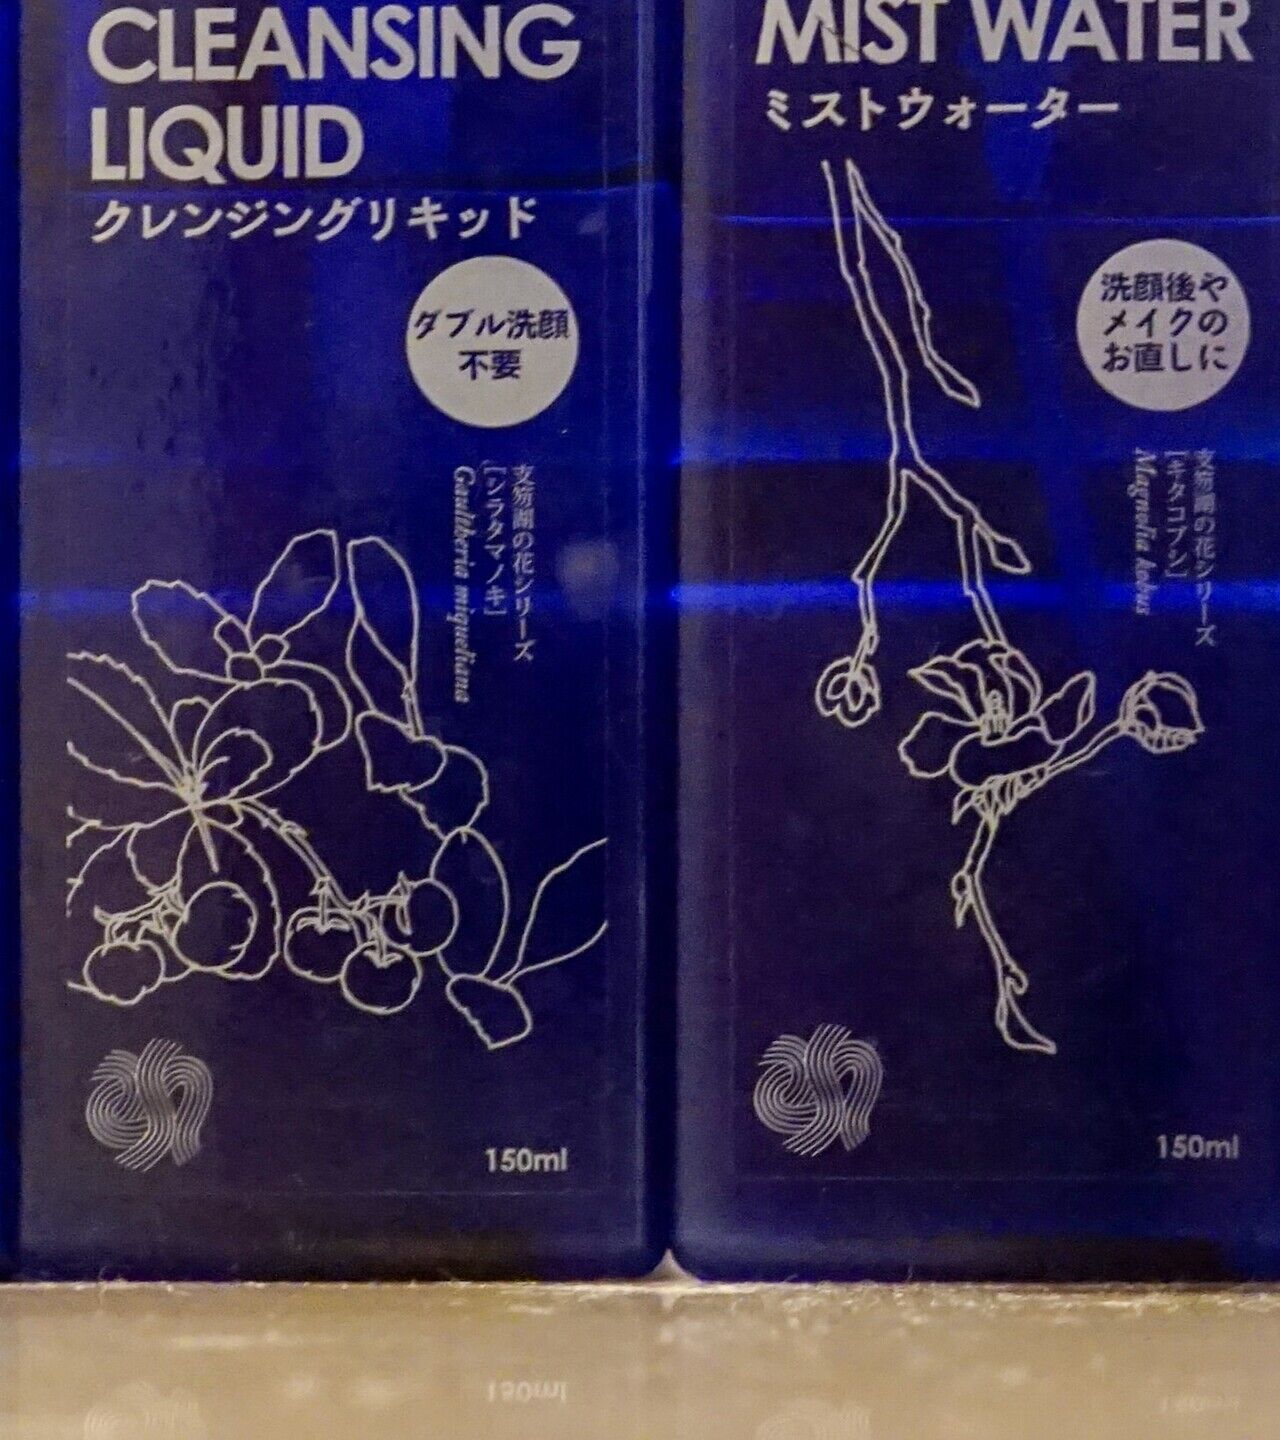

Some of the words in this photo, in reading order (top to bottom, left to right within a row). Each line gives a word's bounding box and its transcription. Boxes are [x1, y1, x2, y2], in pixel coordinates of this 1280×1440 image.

[86, 3, 581, 85] CLEANSING
[766, 86, 1120, 131] ミストウォーター
[90, 104, 364, 185] LIQUID
[90, 196, 536, 244] クレンジングリキッド
[1100, 270, 1228, 303] 洗顔後や
[413, 309, 570, 341] ダブル洗顔
[1103, 307, 1229, 339] メイクの
[458, 349, 522, 381] 不要
[1101, 341, 1229, 373] お直しに
[485, 1147, 568, 1173] 150ml
[1157, 1134, 1240, 1160] 150ml
